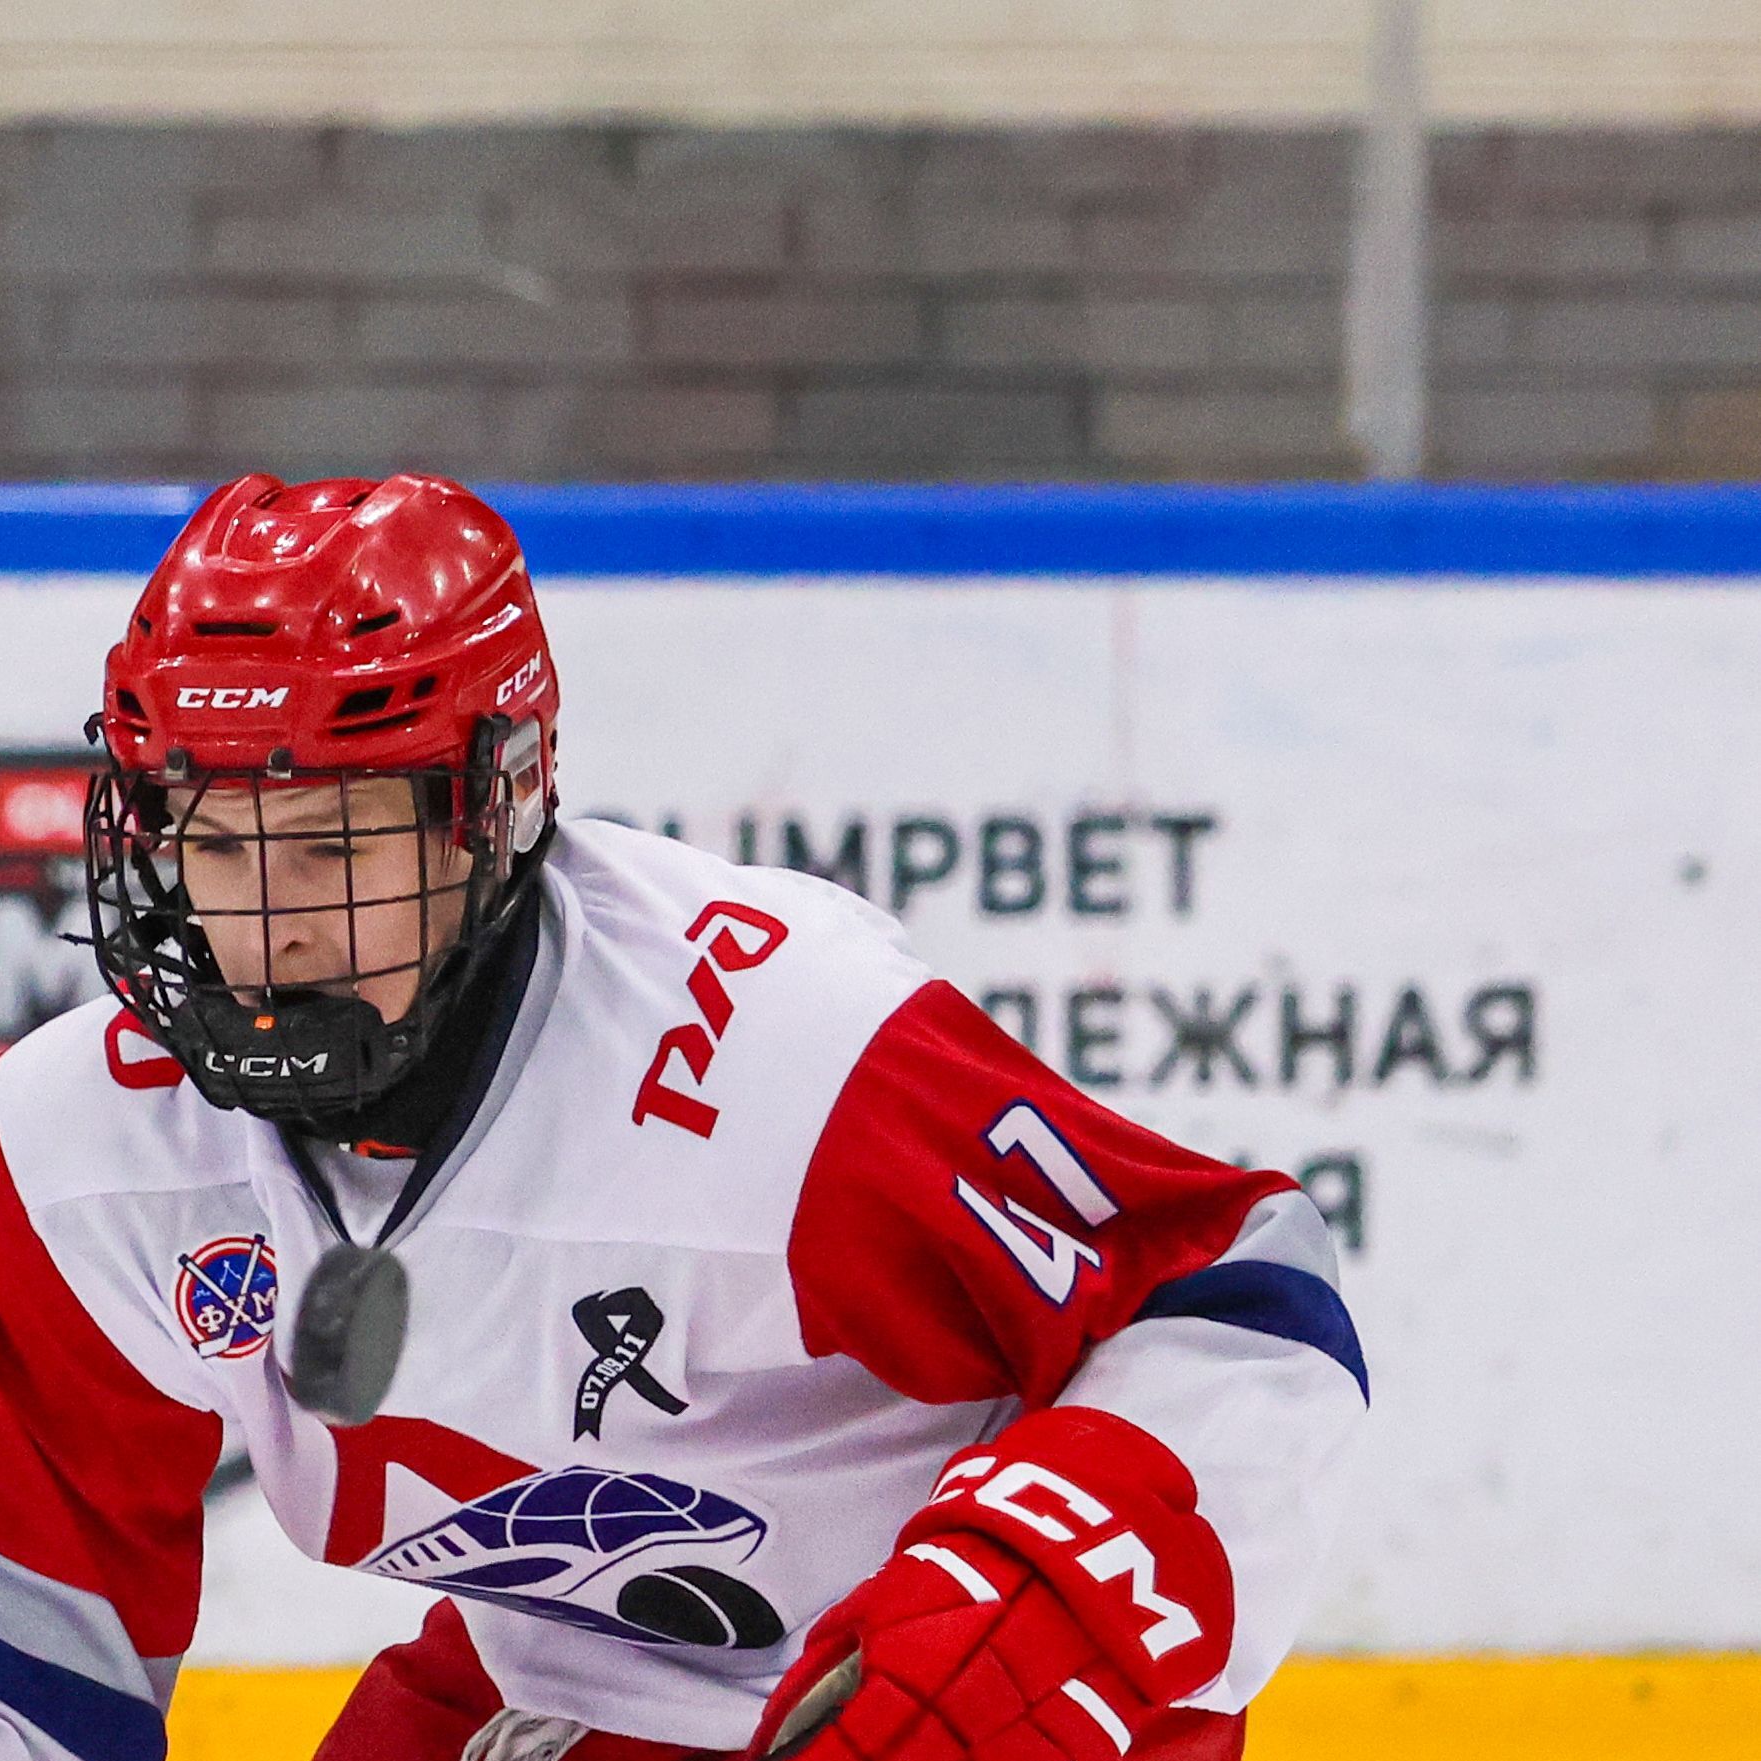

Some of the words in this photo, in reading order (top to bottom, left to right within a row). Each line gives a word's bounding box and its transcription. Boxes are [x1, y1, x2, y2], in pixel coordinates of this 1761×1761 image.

[176, 686, 290, 709] CCM
[495, 649, 543, 707] CCM
[204, 1050, 330, 1078] CCM
[955, 1095, 1123, 1308] 41
[580, 1331, 647, 1411] 07.09.11
[929, 1455, 1203, 1661] CCM
